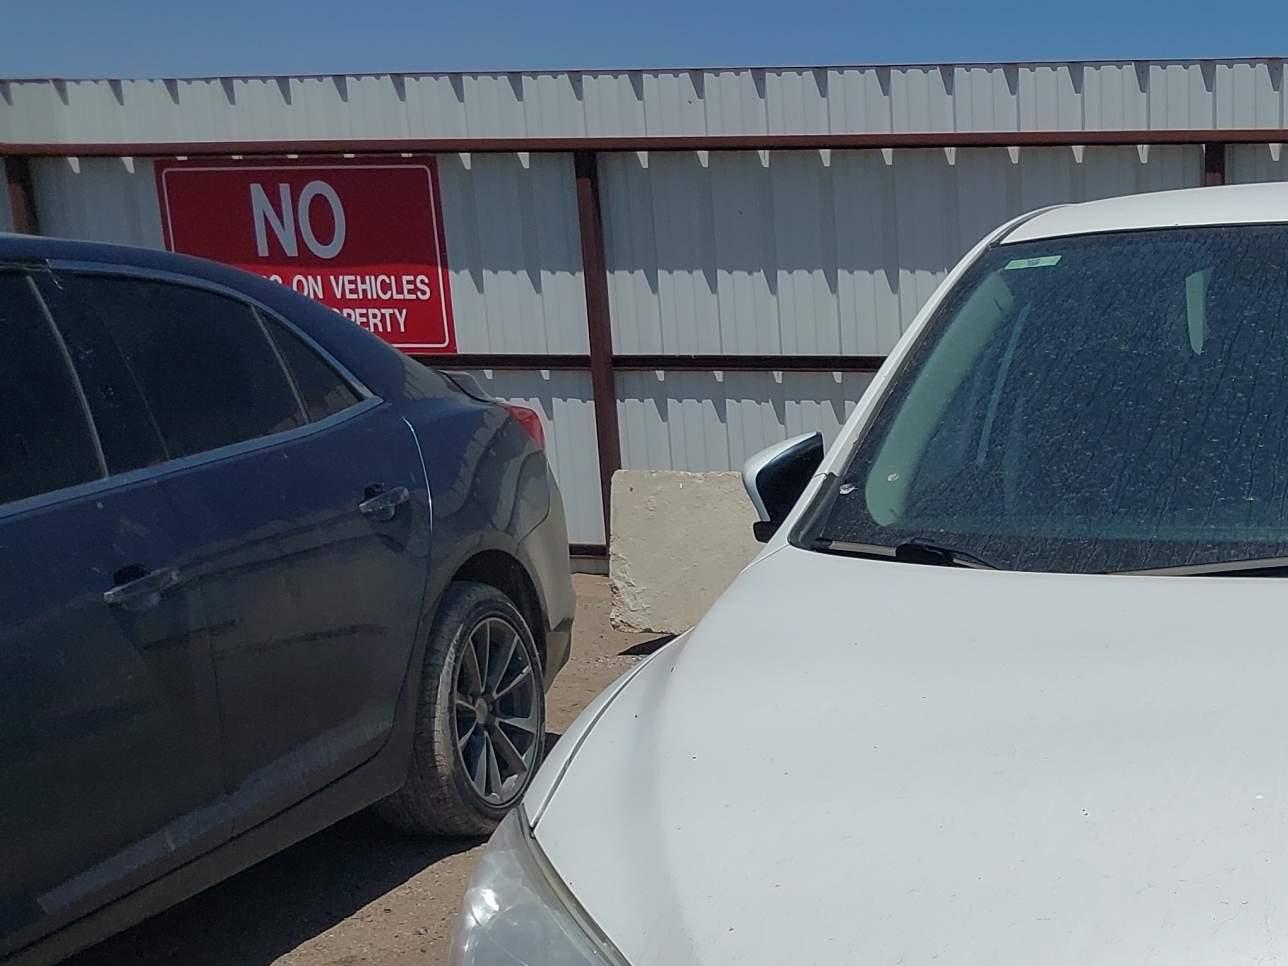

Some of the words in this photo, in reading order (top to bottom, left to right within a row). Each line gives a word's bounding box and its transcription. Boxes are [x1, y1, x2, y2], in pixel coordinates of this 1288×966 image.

[250, 180, 346, 259] NO
[292, 274, 324, 300] ON
[330, 274, 431, 300] VEHICLES
